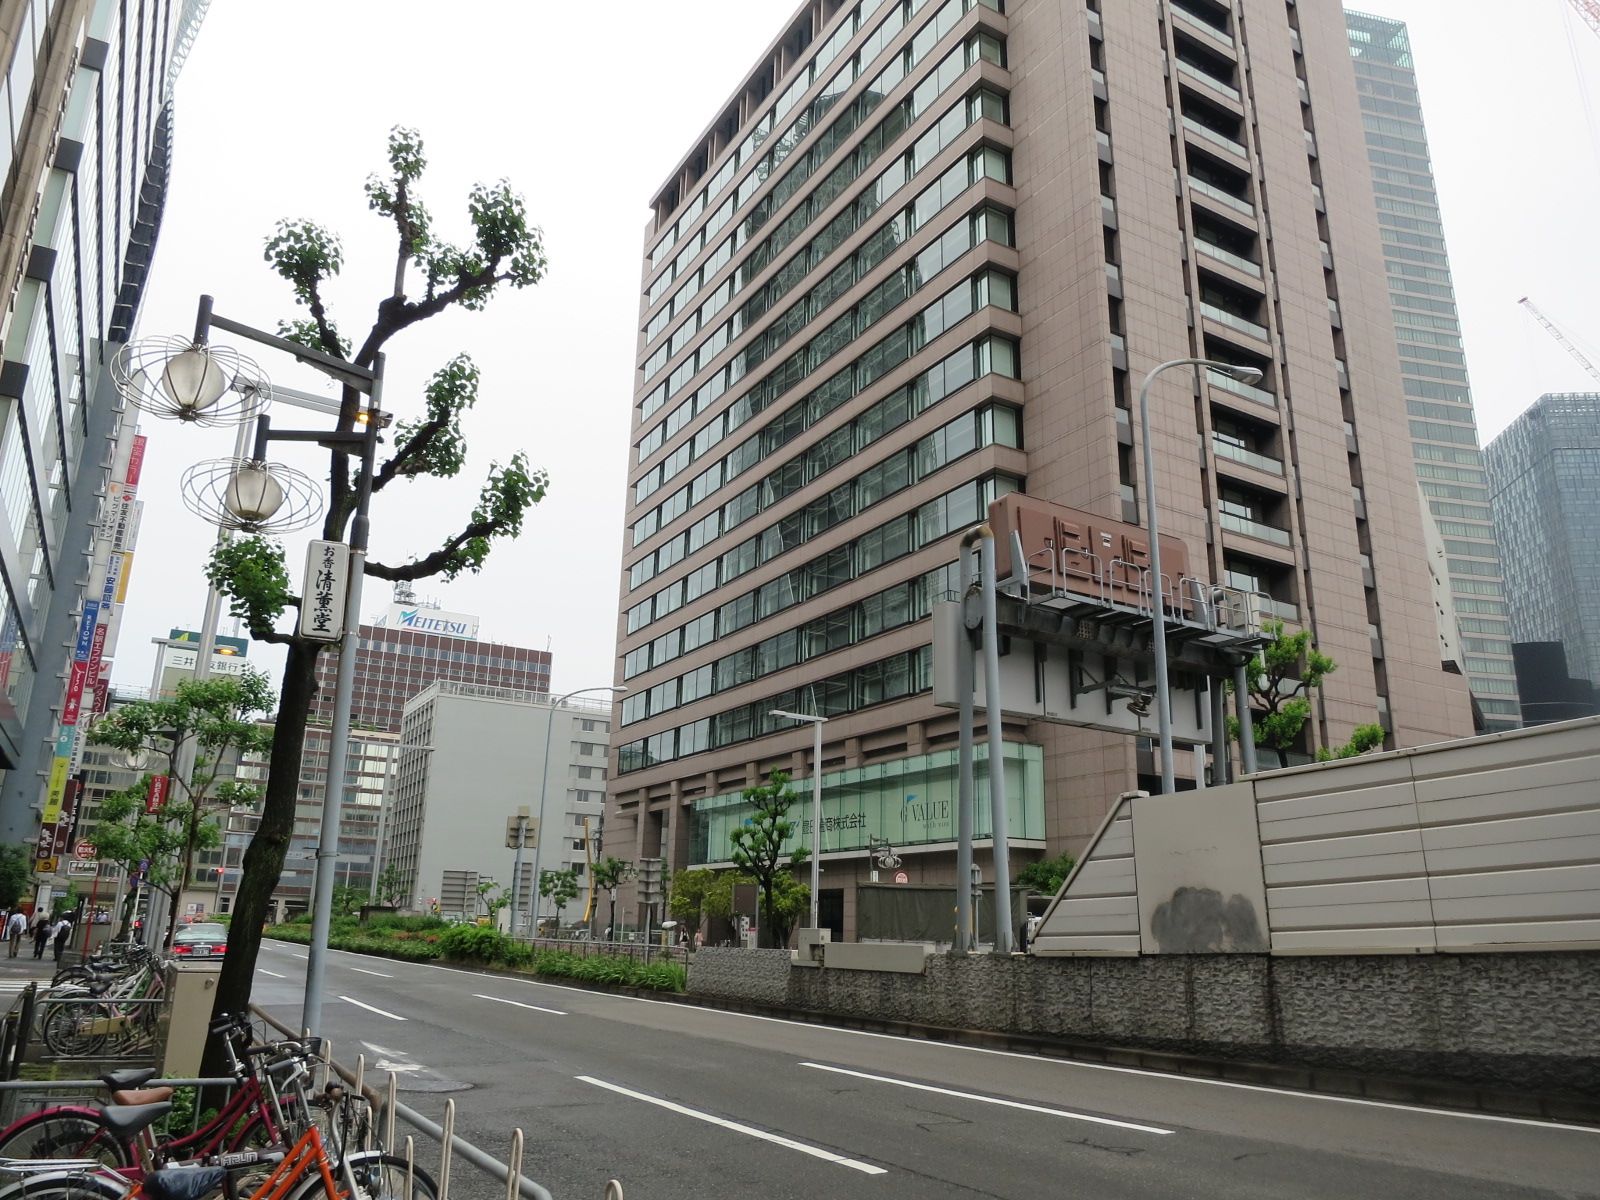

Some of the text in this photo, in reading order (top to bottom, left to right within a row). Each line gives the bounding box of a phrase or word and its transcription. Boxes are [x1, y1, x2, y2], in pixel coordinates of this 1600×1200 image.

[397, 608, 467, 634] MEITETSU
[172, 655, 239, 672] 三井友銀行
[911, 800, 949, 822] VALUE
